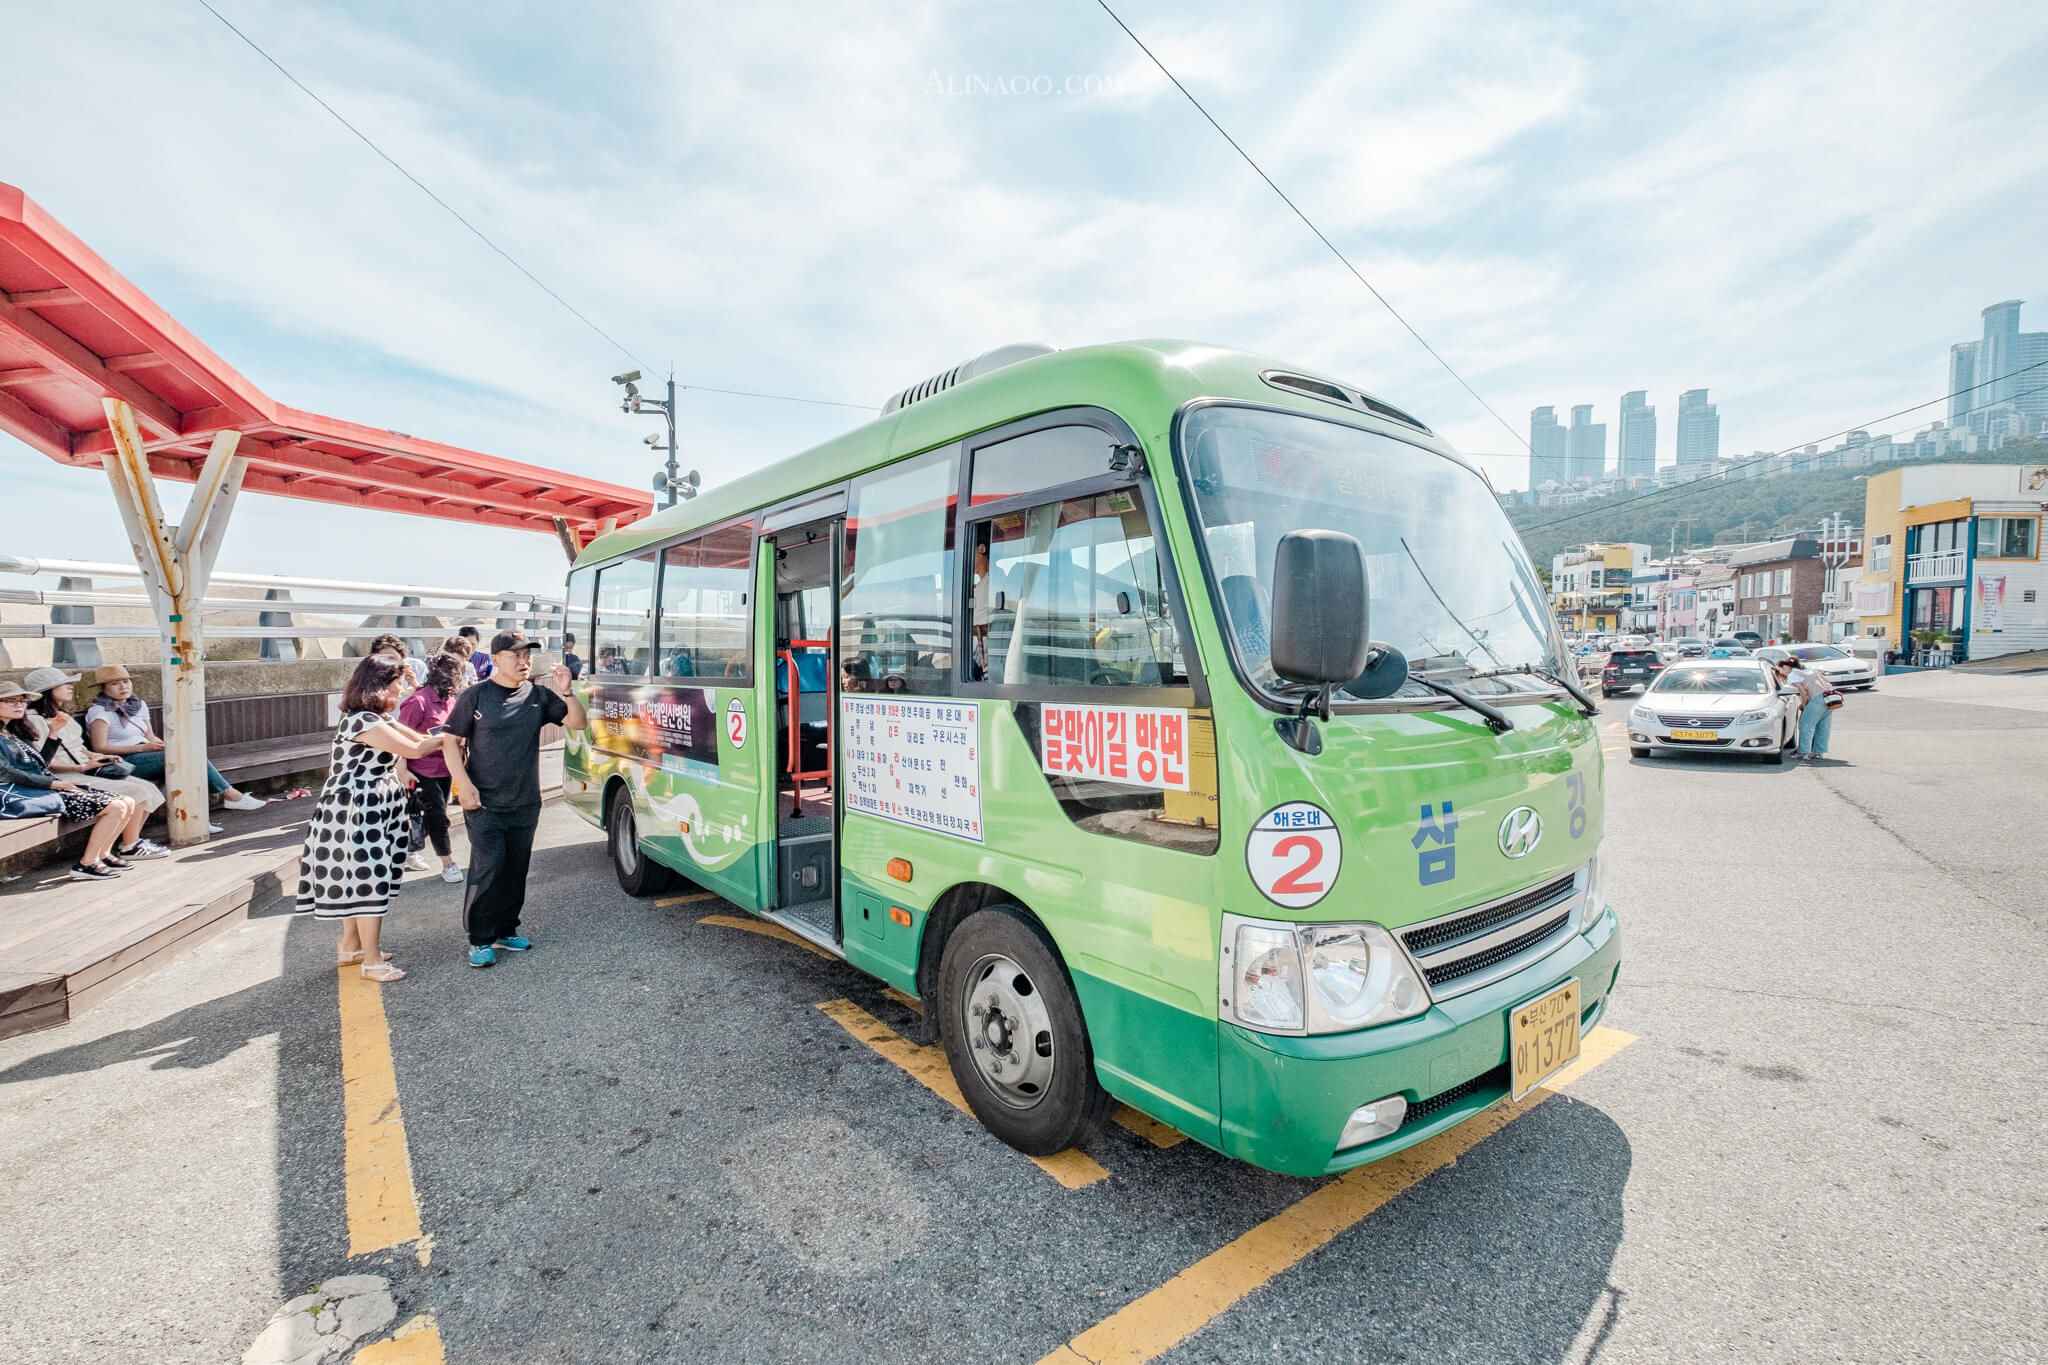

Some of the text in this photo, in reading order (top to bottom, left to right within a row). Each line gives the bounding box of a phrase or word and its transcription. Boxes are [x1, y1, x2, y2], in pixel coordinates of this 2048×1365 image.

[731, 714, 743, 741] 2
[1045, 709, 1128, 778] 달맞이길
[1135, 713, 1184, 785] 방면
[1273, 810, 1321, 827] 해운대
[1566, 771, 1586, 839] 강
[1271, 835, 1324, 894] 2
[1411, 801, 1459, 886] 삼
